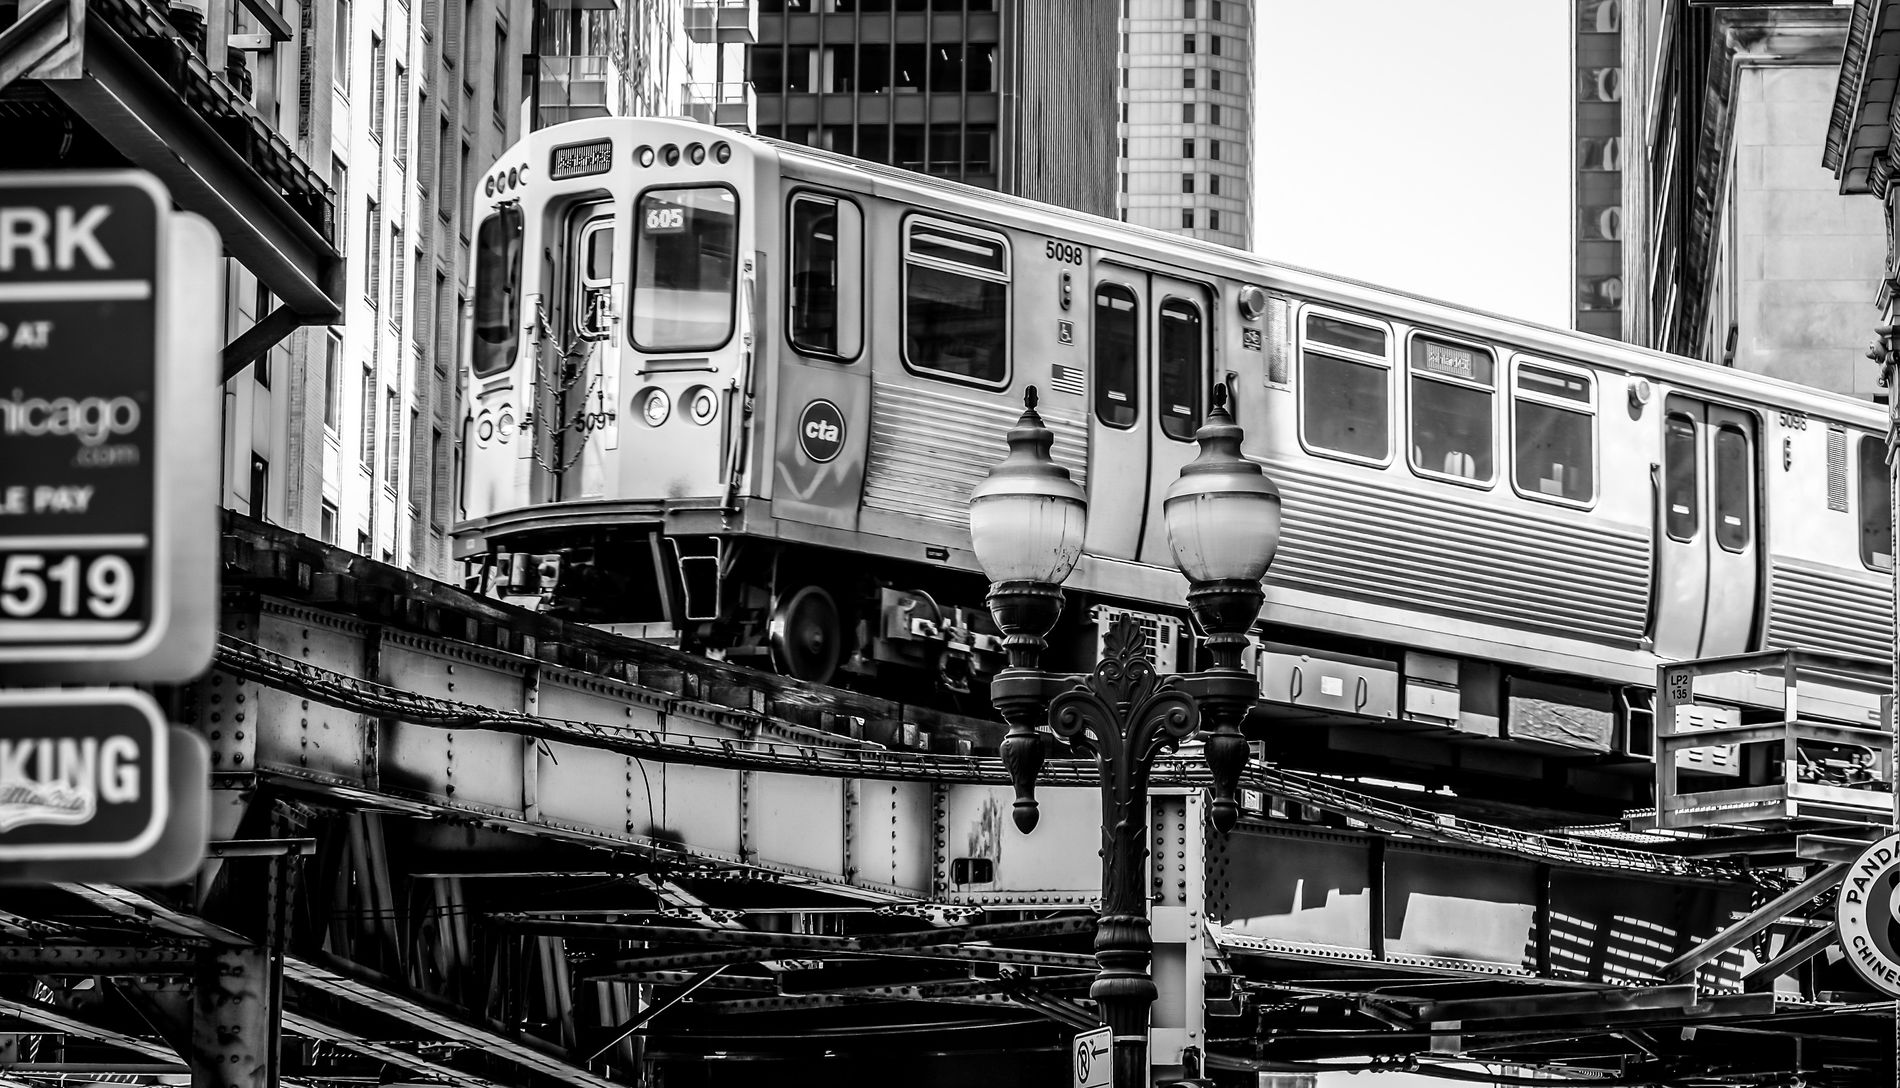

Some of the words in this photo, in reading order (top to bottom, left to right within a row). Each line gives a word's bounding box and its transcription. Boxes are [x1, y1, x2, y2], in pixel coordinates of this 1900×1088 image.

[647, 209, 683, 228] 605
[1046, 240, 1083, 266] 5098
[805, 420, 839, 442] cta
[33, 485, 94, 514] PAY
[0, 554, 135, 618] 519
[1671, 675, 1688, 685] LP2
[1672, 689, 1687, 699] 135
